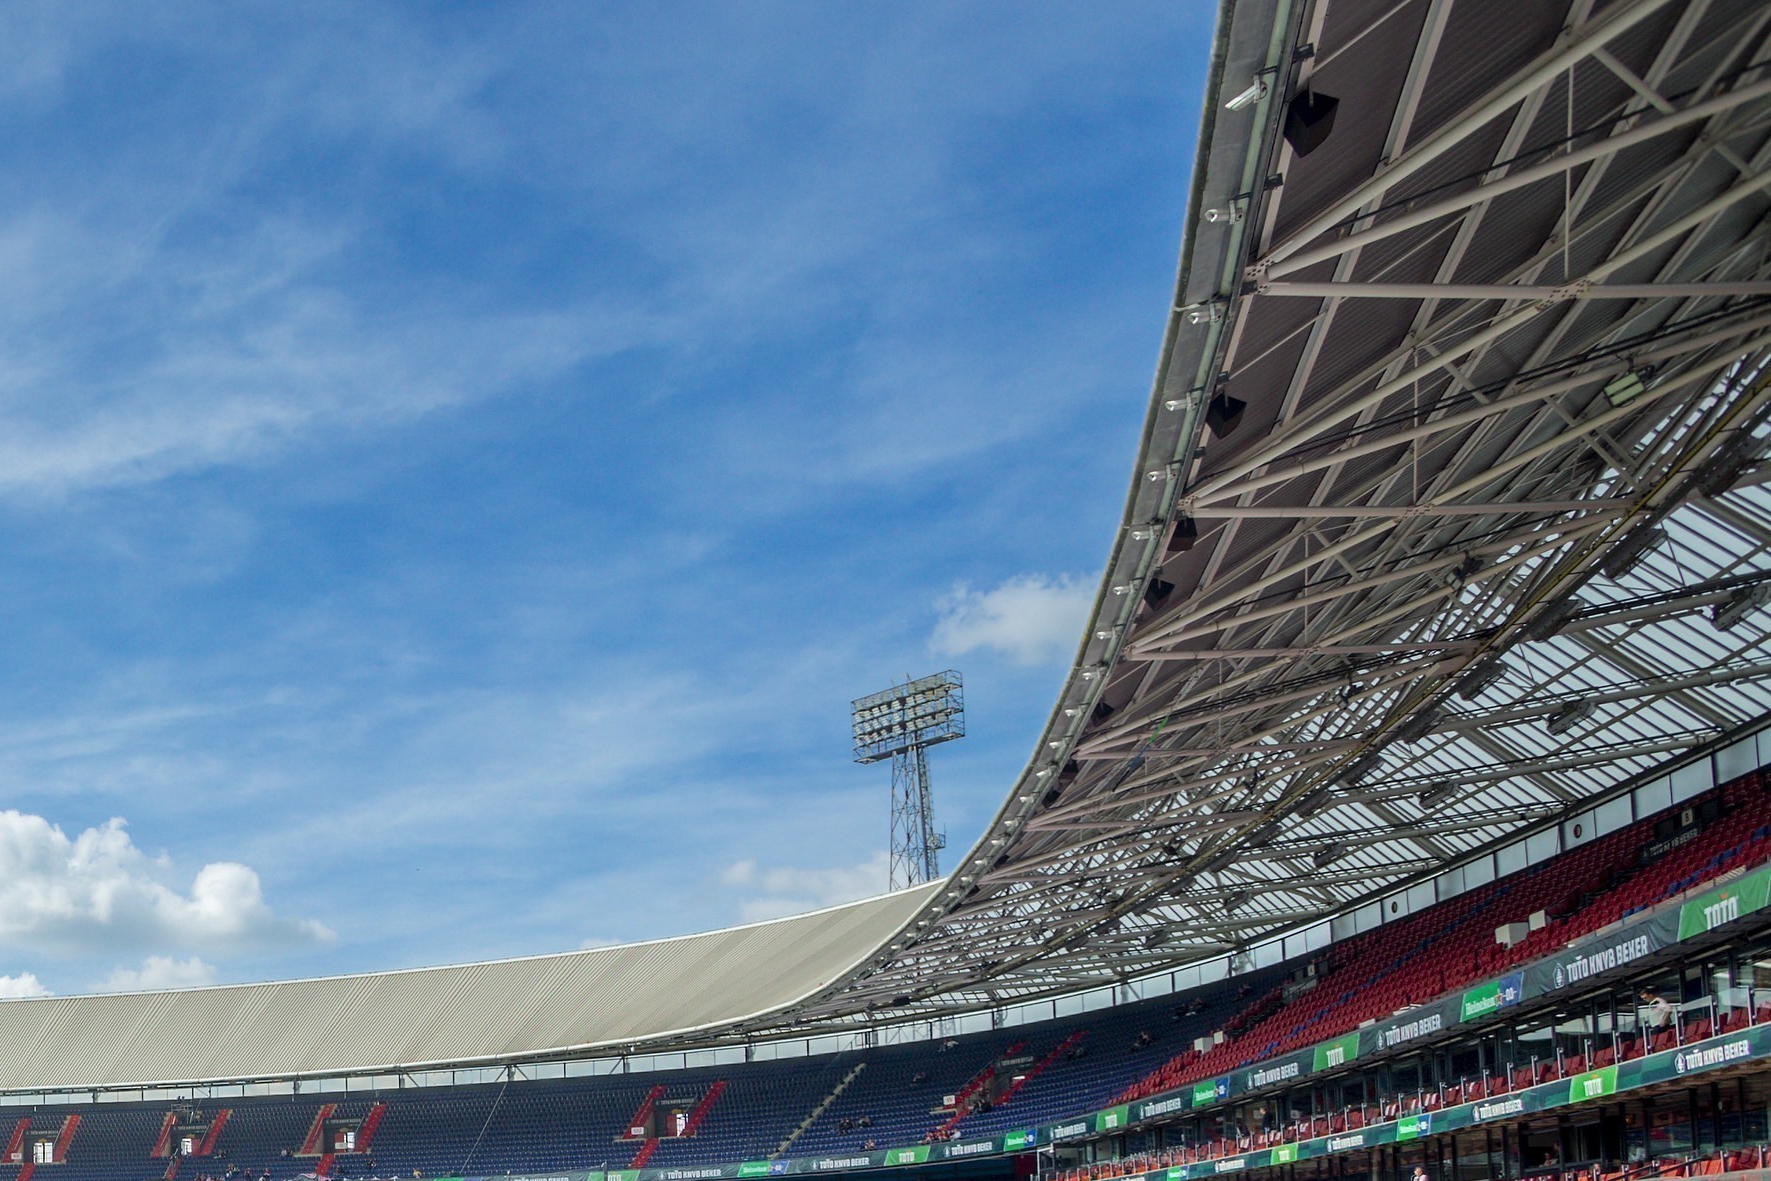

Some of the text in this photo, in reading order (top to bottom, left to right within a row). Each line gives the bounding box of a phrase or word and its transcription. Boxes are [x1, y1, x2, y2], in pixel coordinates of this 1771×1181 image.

[1704, 896, 1738, 930] TOTO
[1567, 935, 1648, 982] TOTO KNVB BEKER
[1466, 996, 1496, 1014] Heineken
[1327, 1047, 1344, 1067] TOTO
[1583, 1079, 1602, 1096] TOTO
[899, 1152, 915, 1162] TOTO
